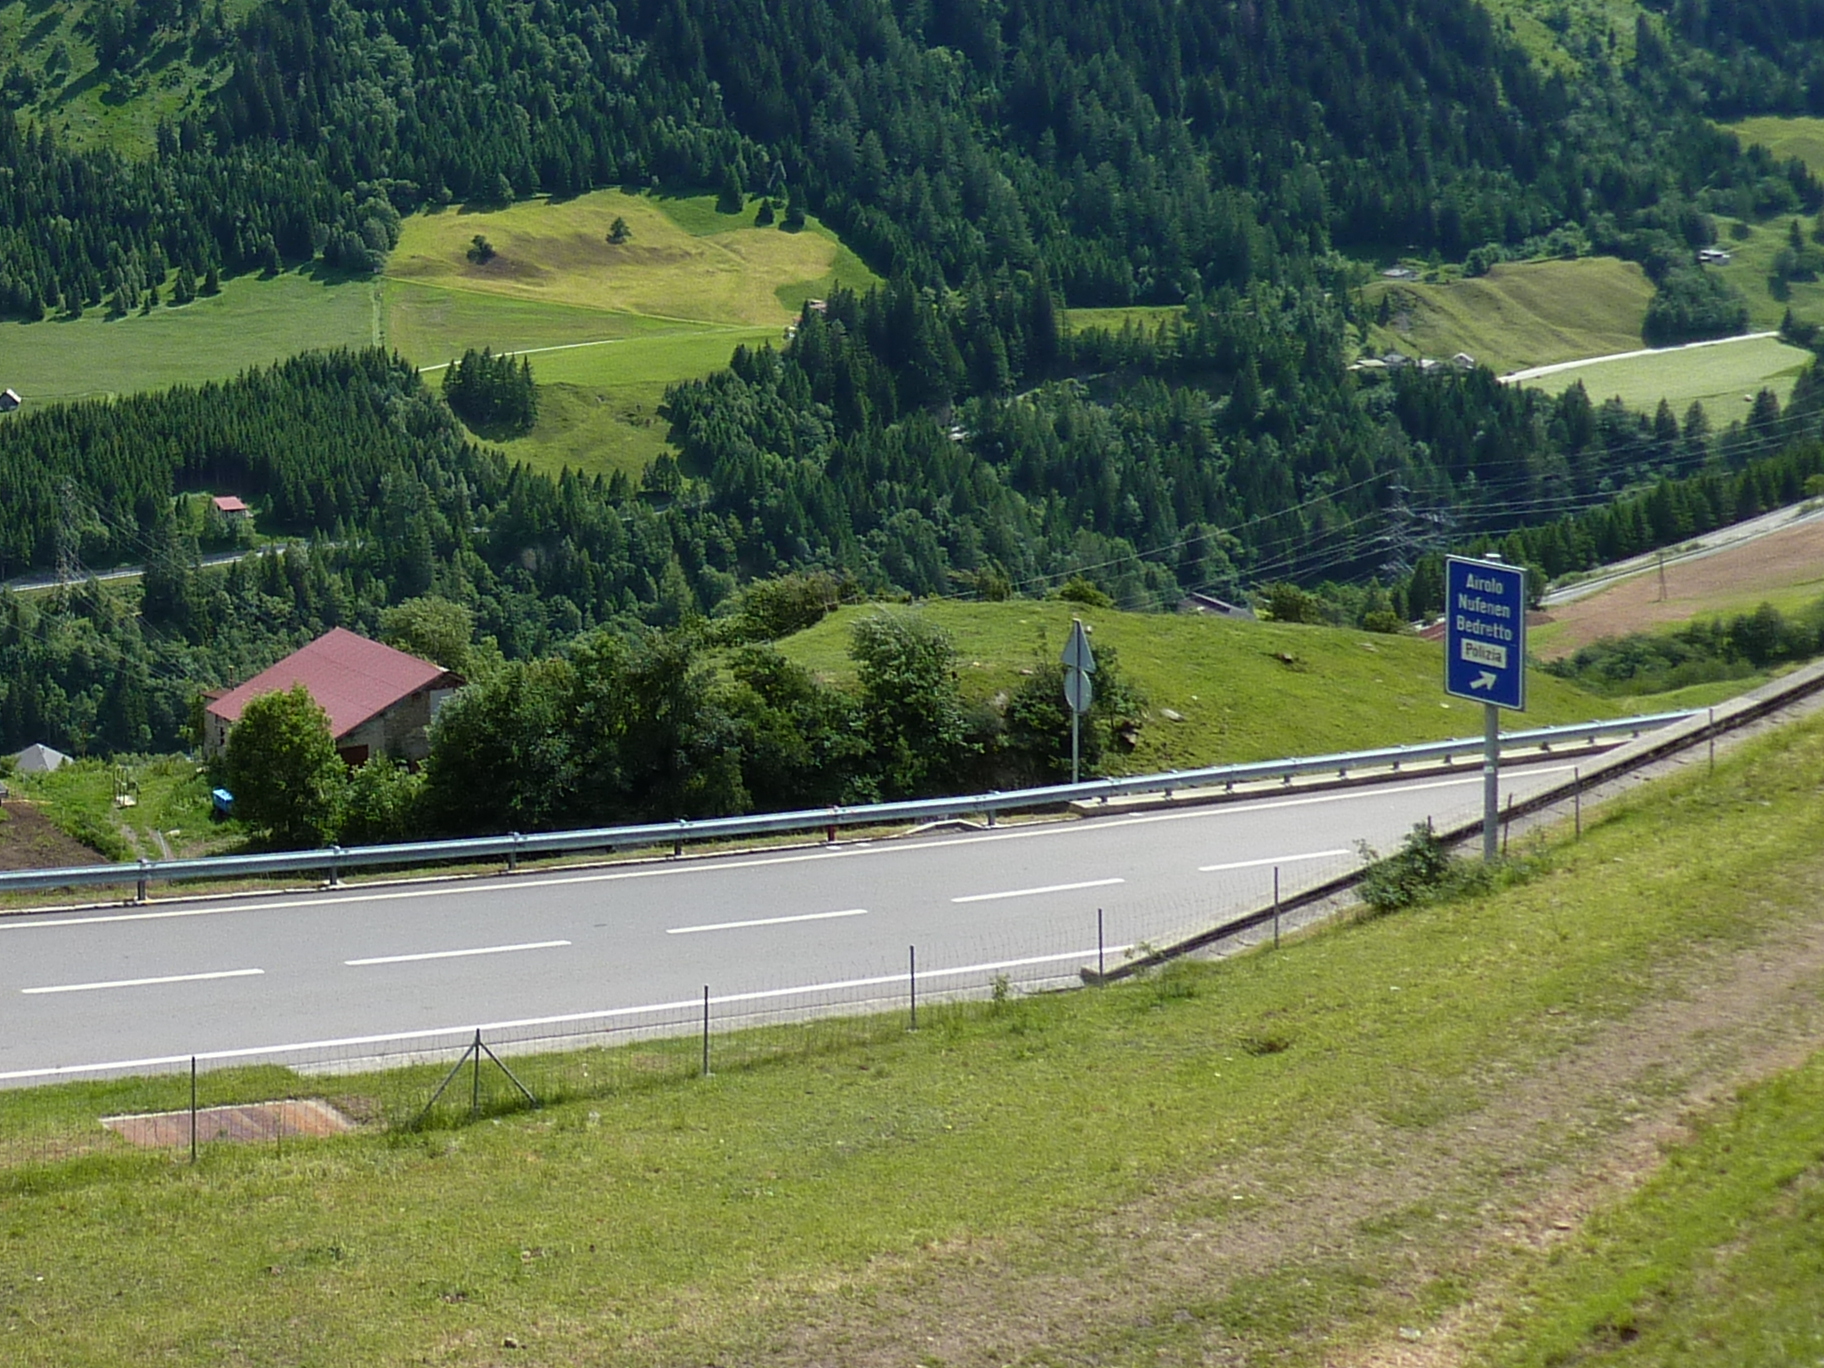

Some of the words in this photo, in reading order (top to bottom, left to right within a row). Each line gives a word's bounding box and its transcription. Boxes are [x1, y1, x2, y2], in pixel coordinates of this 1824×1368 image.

[1466, 573, 1503, 594] Airolo
[1458, 593, 1510, 618] Nufenen
[1456, 615, 1512, 641] Bedretto
[1465, 642, 1502, 663] Polizia
